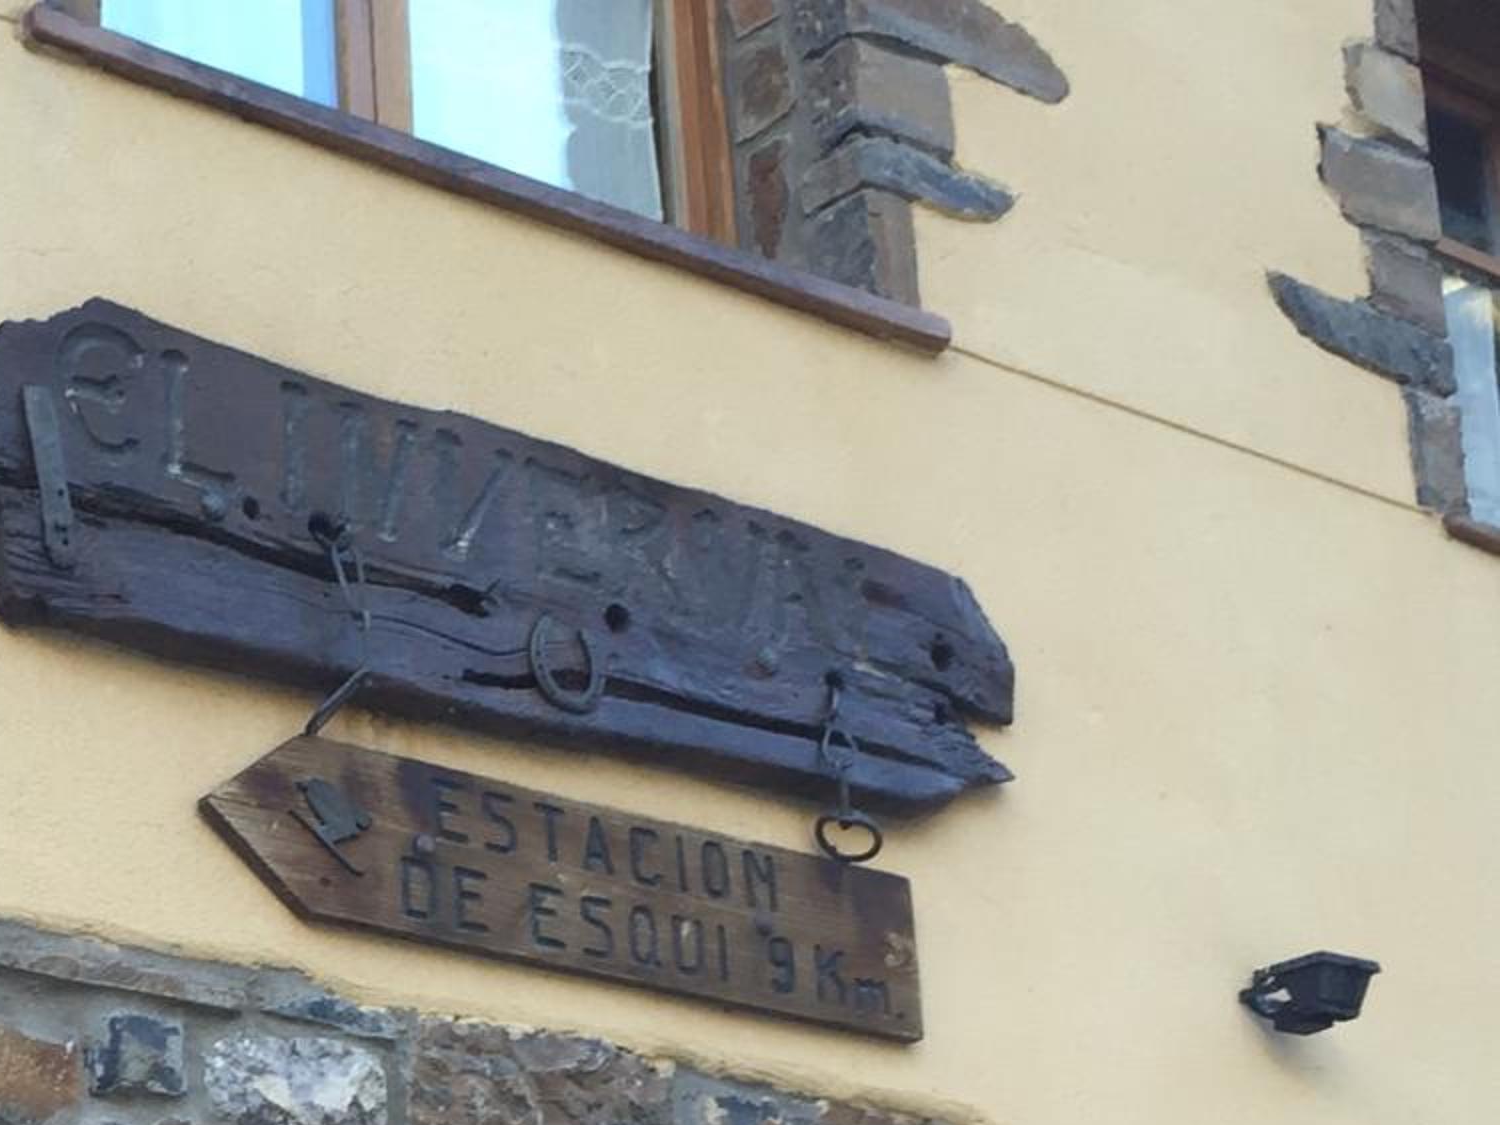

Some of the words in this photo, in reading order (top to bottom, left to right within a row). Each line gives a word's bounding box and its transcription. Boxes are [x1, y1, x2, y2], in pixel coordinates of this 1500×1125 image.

[430, 777, 779, 912] ESTACION
[400, 854, 490, 934] DE
[528, 881, 730, 982] ESQUI
